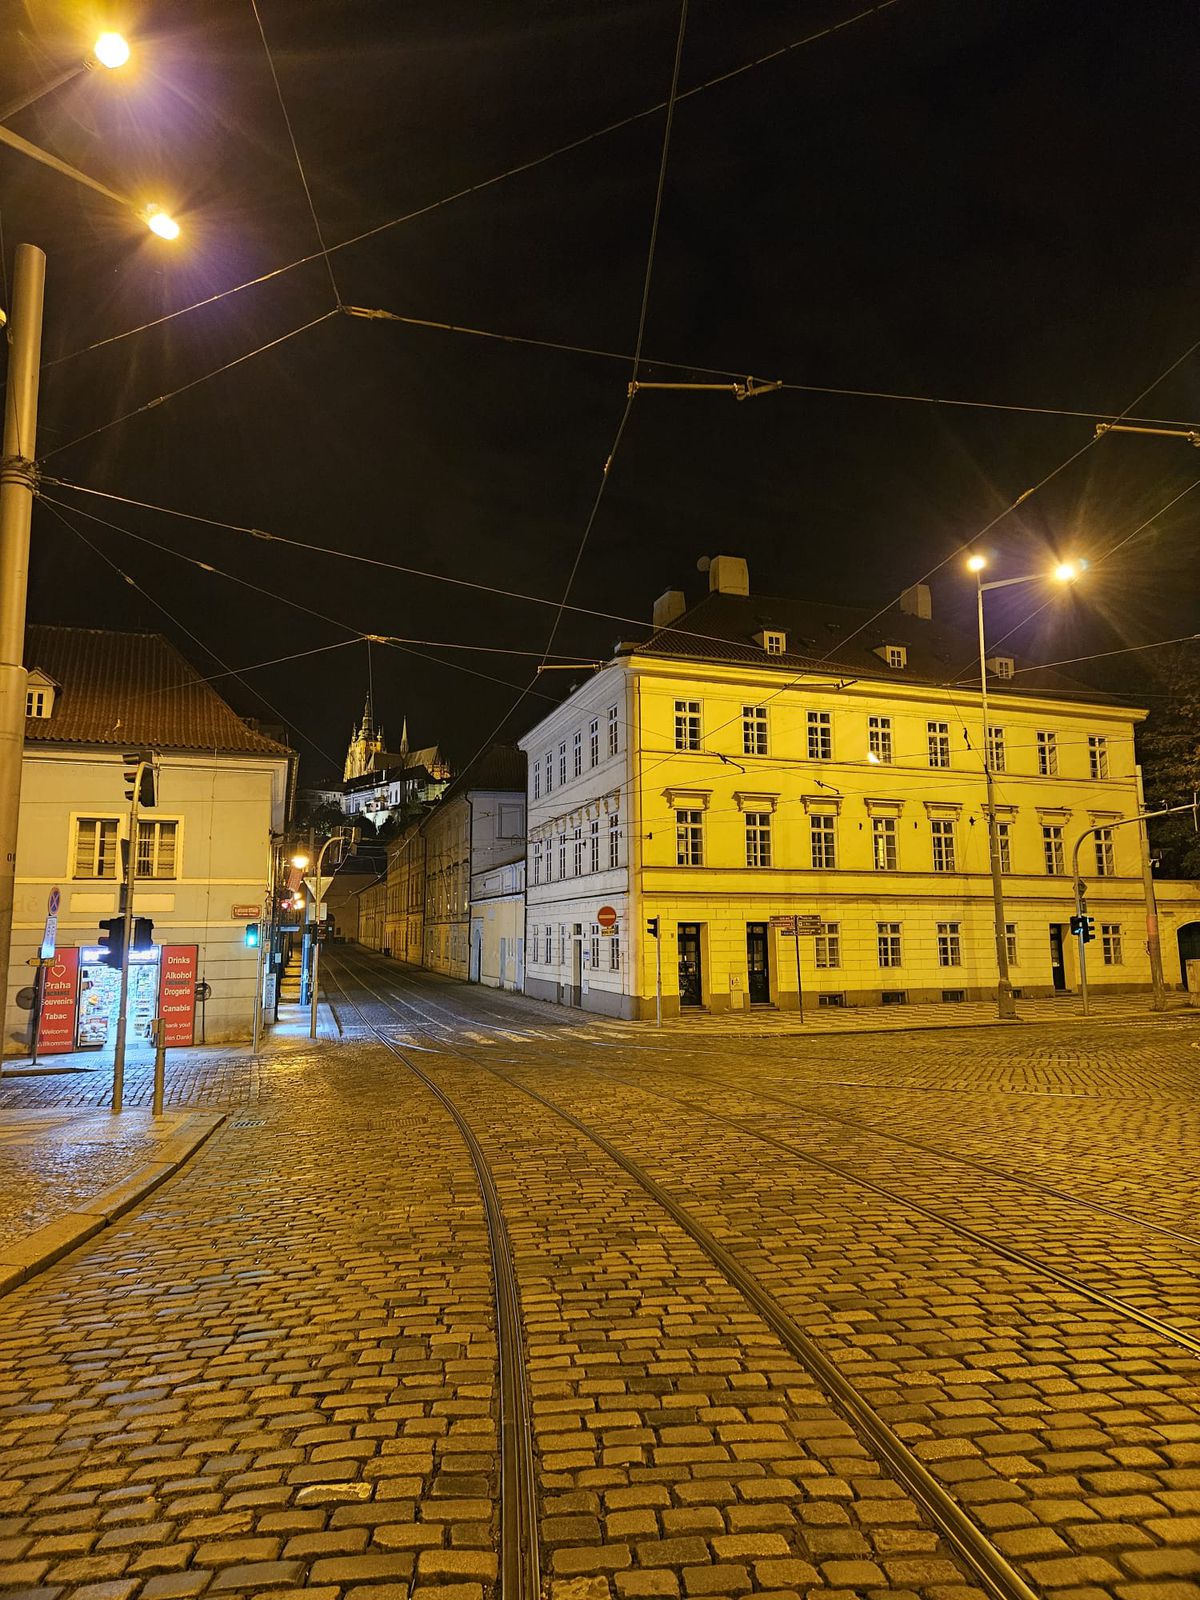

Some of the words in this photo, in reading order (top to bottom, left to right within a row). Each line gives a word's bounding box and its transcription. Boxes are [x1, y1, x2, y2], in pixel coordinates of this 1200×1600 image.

[167, 956, 190, 964] Drinks
[165, 971, 192, 979] Alkohol
[45, 981, 71, 990] Praha
[164, 987, 190, 997] Drogerie
[162, 1004, 191, 1012] Canabis
